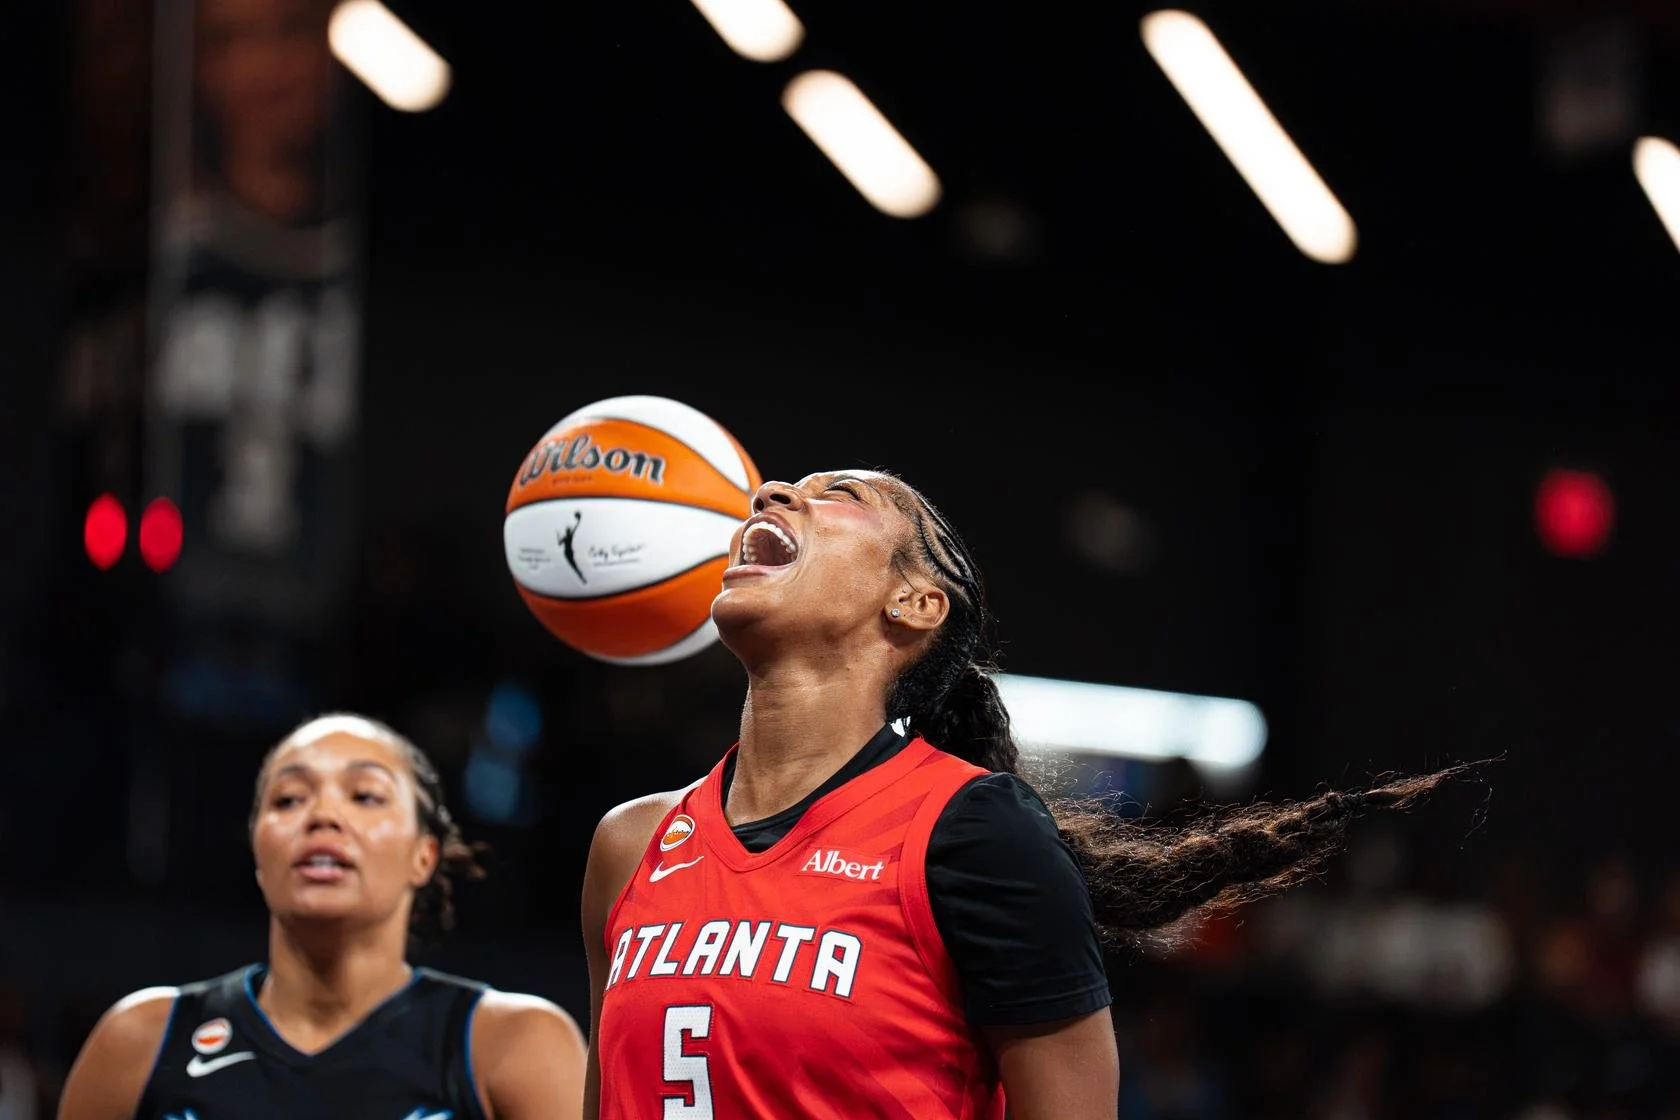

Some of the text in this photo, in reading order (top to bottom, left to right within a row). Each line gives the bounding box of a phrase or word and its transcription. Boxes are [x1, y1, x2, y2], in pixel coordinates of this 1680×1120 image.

[518, 433, 666, 486] Wilson
[801, 849, 884, 881] Albert
[605, 920, 862, 999] ATLANTA
[662, 1003, 715, 1120] 5
